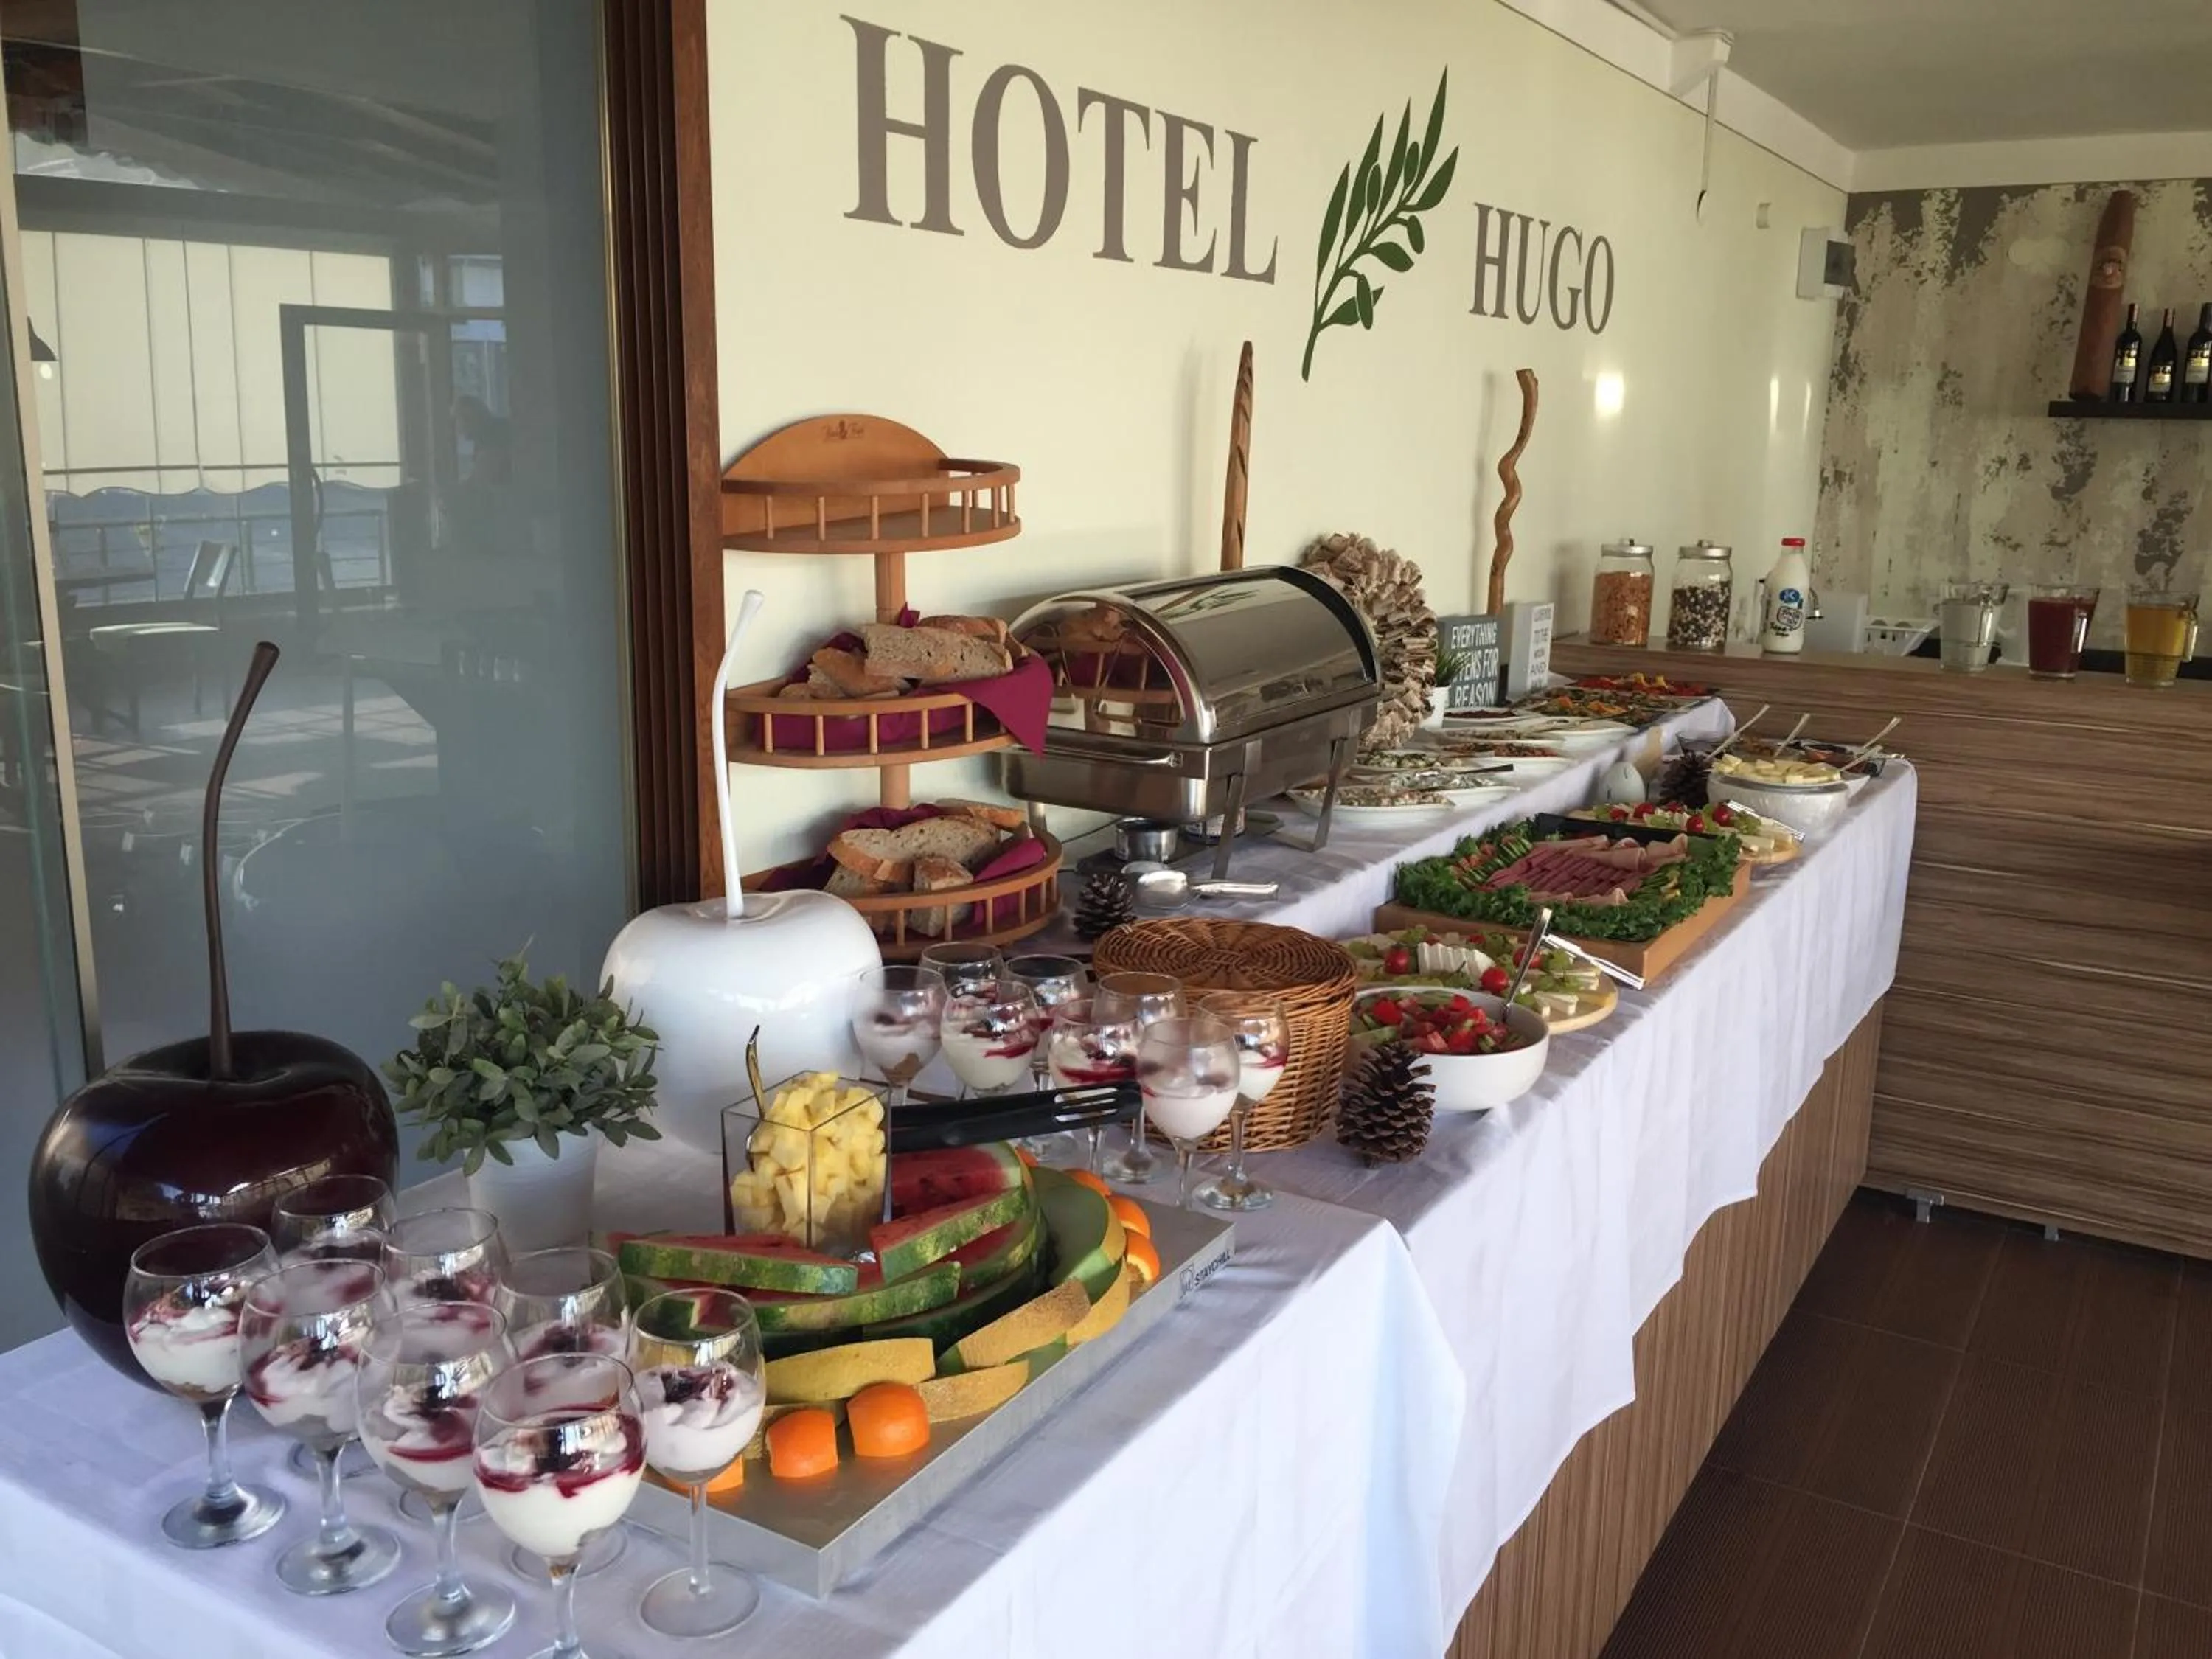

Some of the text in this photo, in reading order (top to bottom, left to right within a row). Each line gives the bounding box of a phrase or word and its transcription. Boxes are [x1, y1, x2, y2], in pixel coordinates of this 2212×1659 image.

[840, 14, 1615, 335] HOTEL HUGO
[1450, 622, 1498, 650] EVERYTHING
[1482, 647, 1499, 678] FOR
[1455, 681, 1497, 708] REASON
